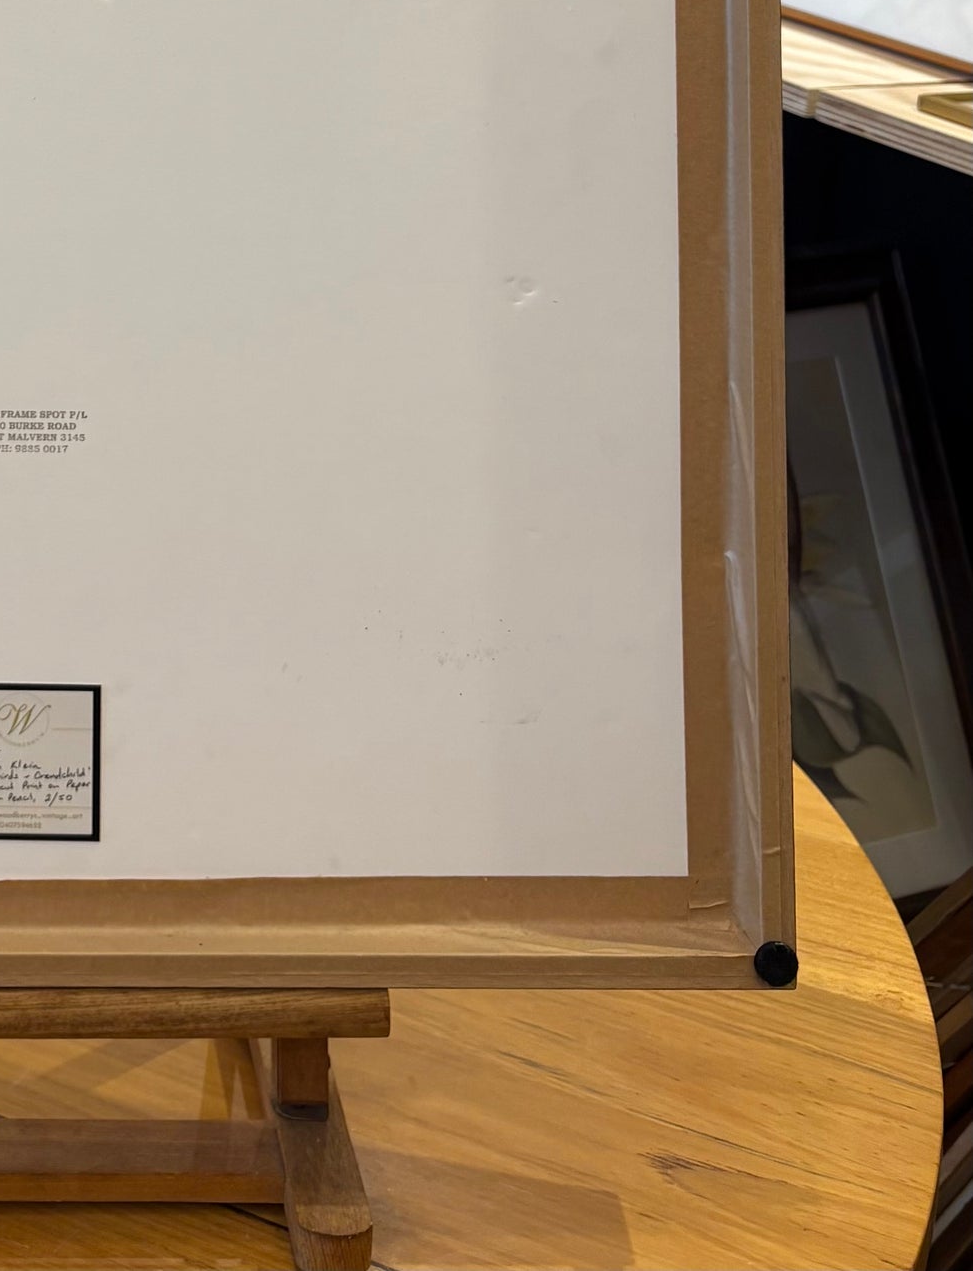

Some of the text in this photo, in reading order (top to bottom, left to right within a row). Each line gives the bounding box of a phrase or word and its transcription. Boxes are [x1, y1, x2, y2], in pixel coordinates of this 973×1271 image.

[0, 410, 36, 418] FRAME
[39, 410, 66, 418] SPOT
[69, 411, 88, 419] P/L
[9, 422, 44, 430] BURKE
[48, 422, 77, 430] ROAD
[8, 433, 57, 441] MALVERN
[60, 433, 86, 441] 3145
[43, 444, 68, 453] 0017
